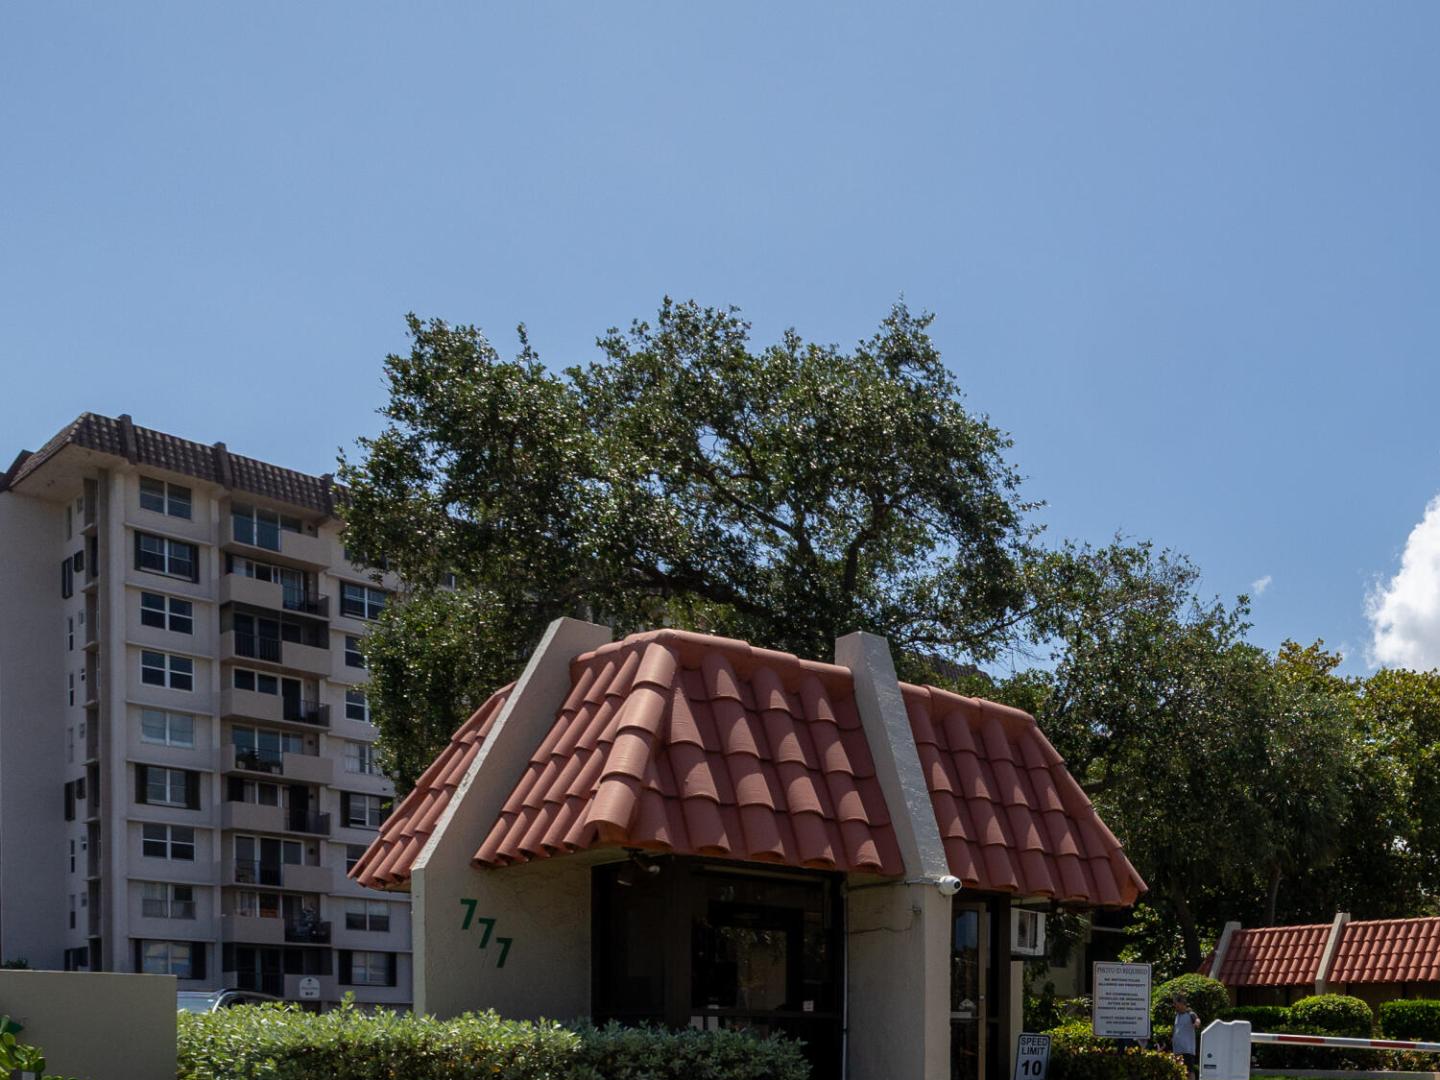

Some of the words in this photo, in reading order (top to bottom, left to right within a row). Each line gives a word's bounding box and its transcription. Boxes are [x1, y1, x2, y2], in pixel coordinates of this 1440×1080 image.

[461, 898, 513, 969] 777
[1021, 1037, 1048, 1046] SPEED
[1021, 1046, 1046, 1056] LIMIT
[1022, 1059, 1042, 1076] 10
